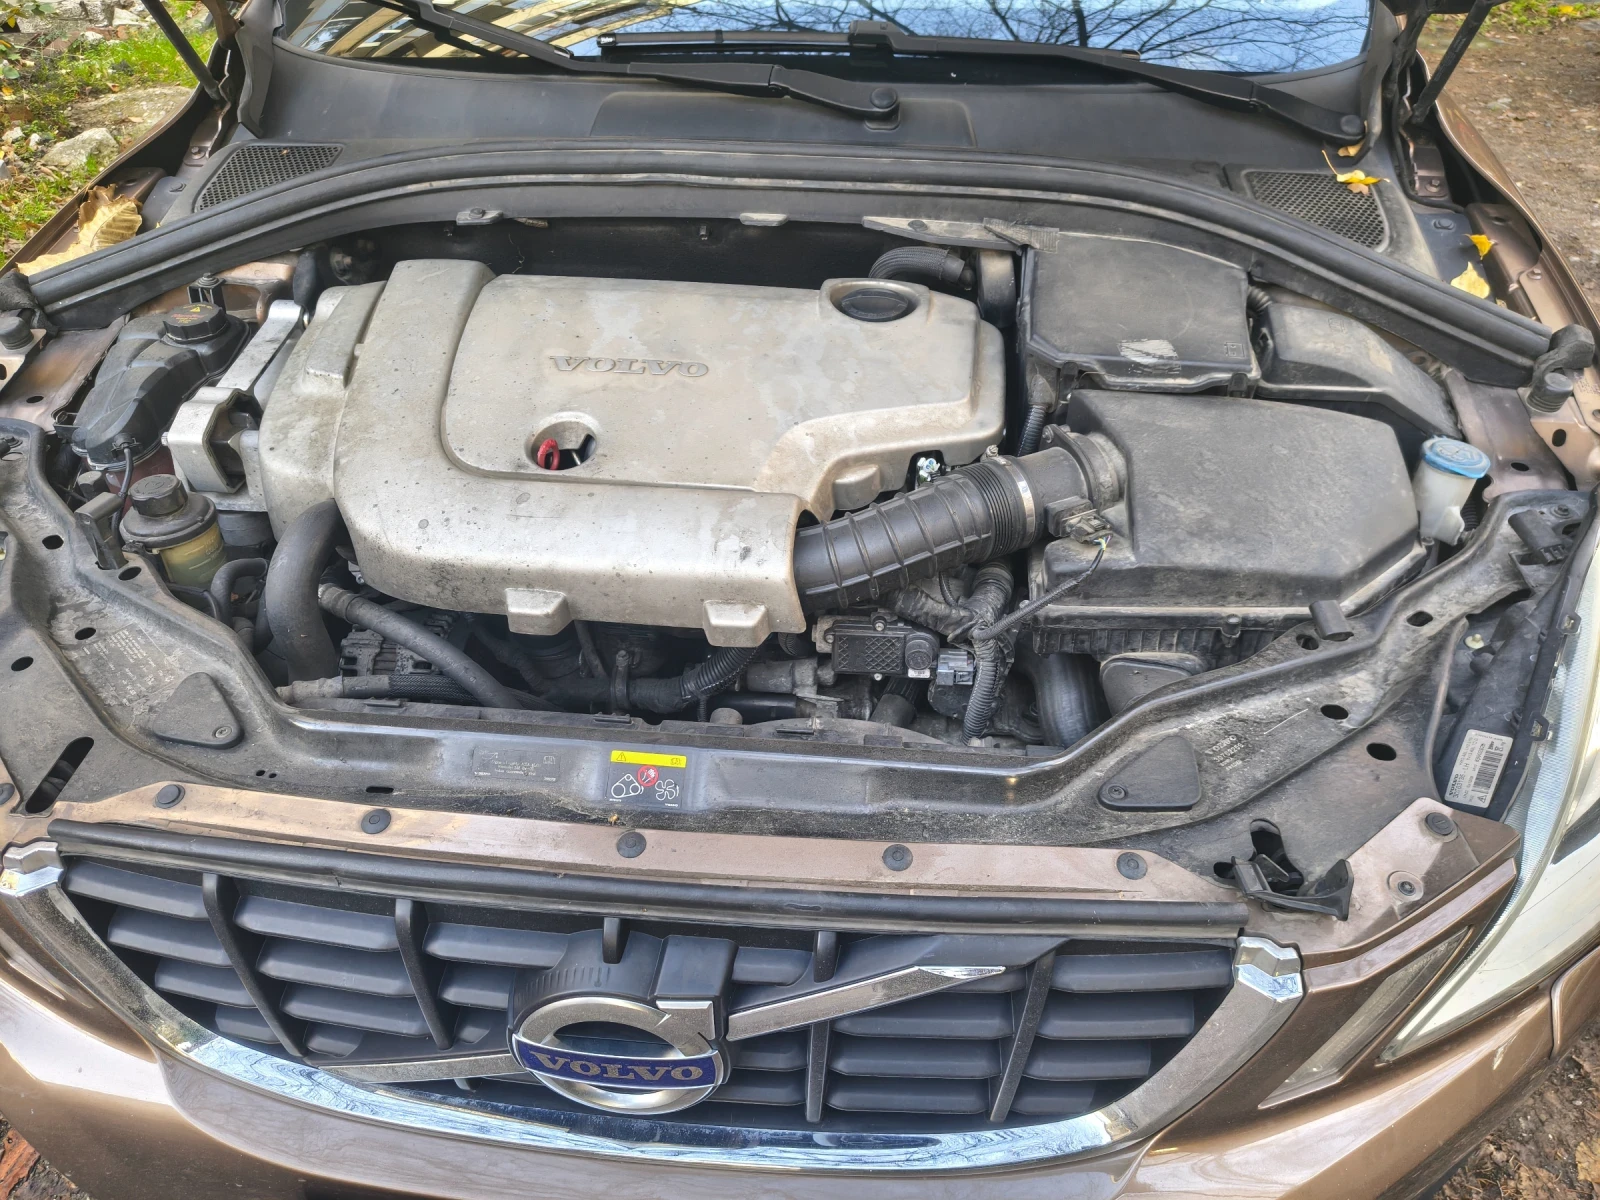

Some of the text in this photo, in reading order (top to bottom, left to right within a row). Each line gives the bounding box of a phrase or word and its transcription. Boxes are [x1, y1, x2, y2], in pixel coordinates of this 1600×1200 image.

[549, 356, 709, 377] VOLVO
[1205, 734, 1237, 754] VOLVO
[1448, 773, 1459, 796] VOLVO
[529, 1050, 703, 1080] VOLVO
